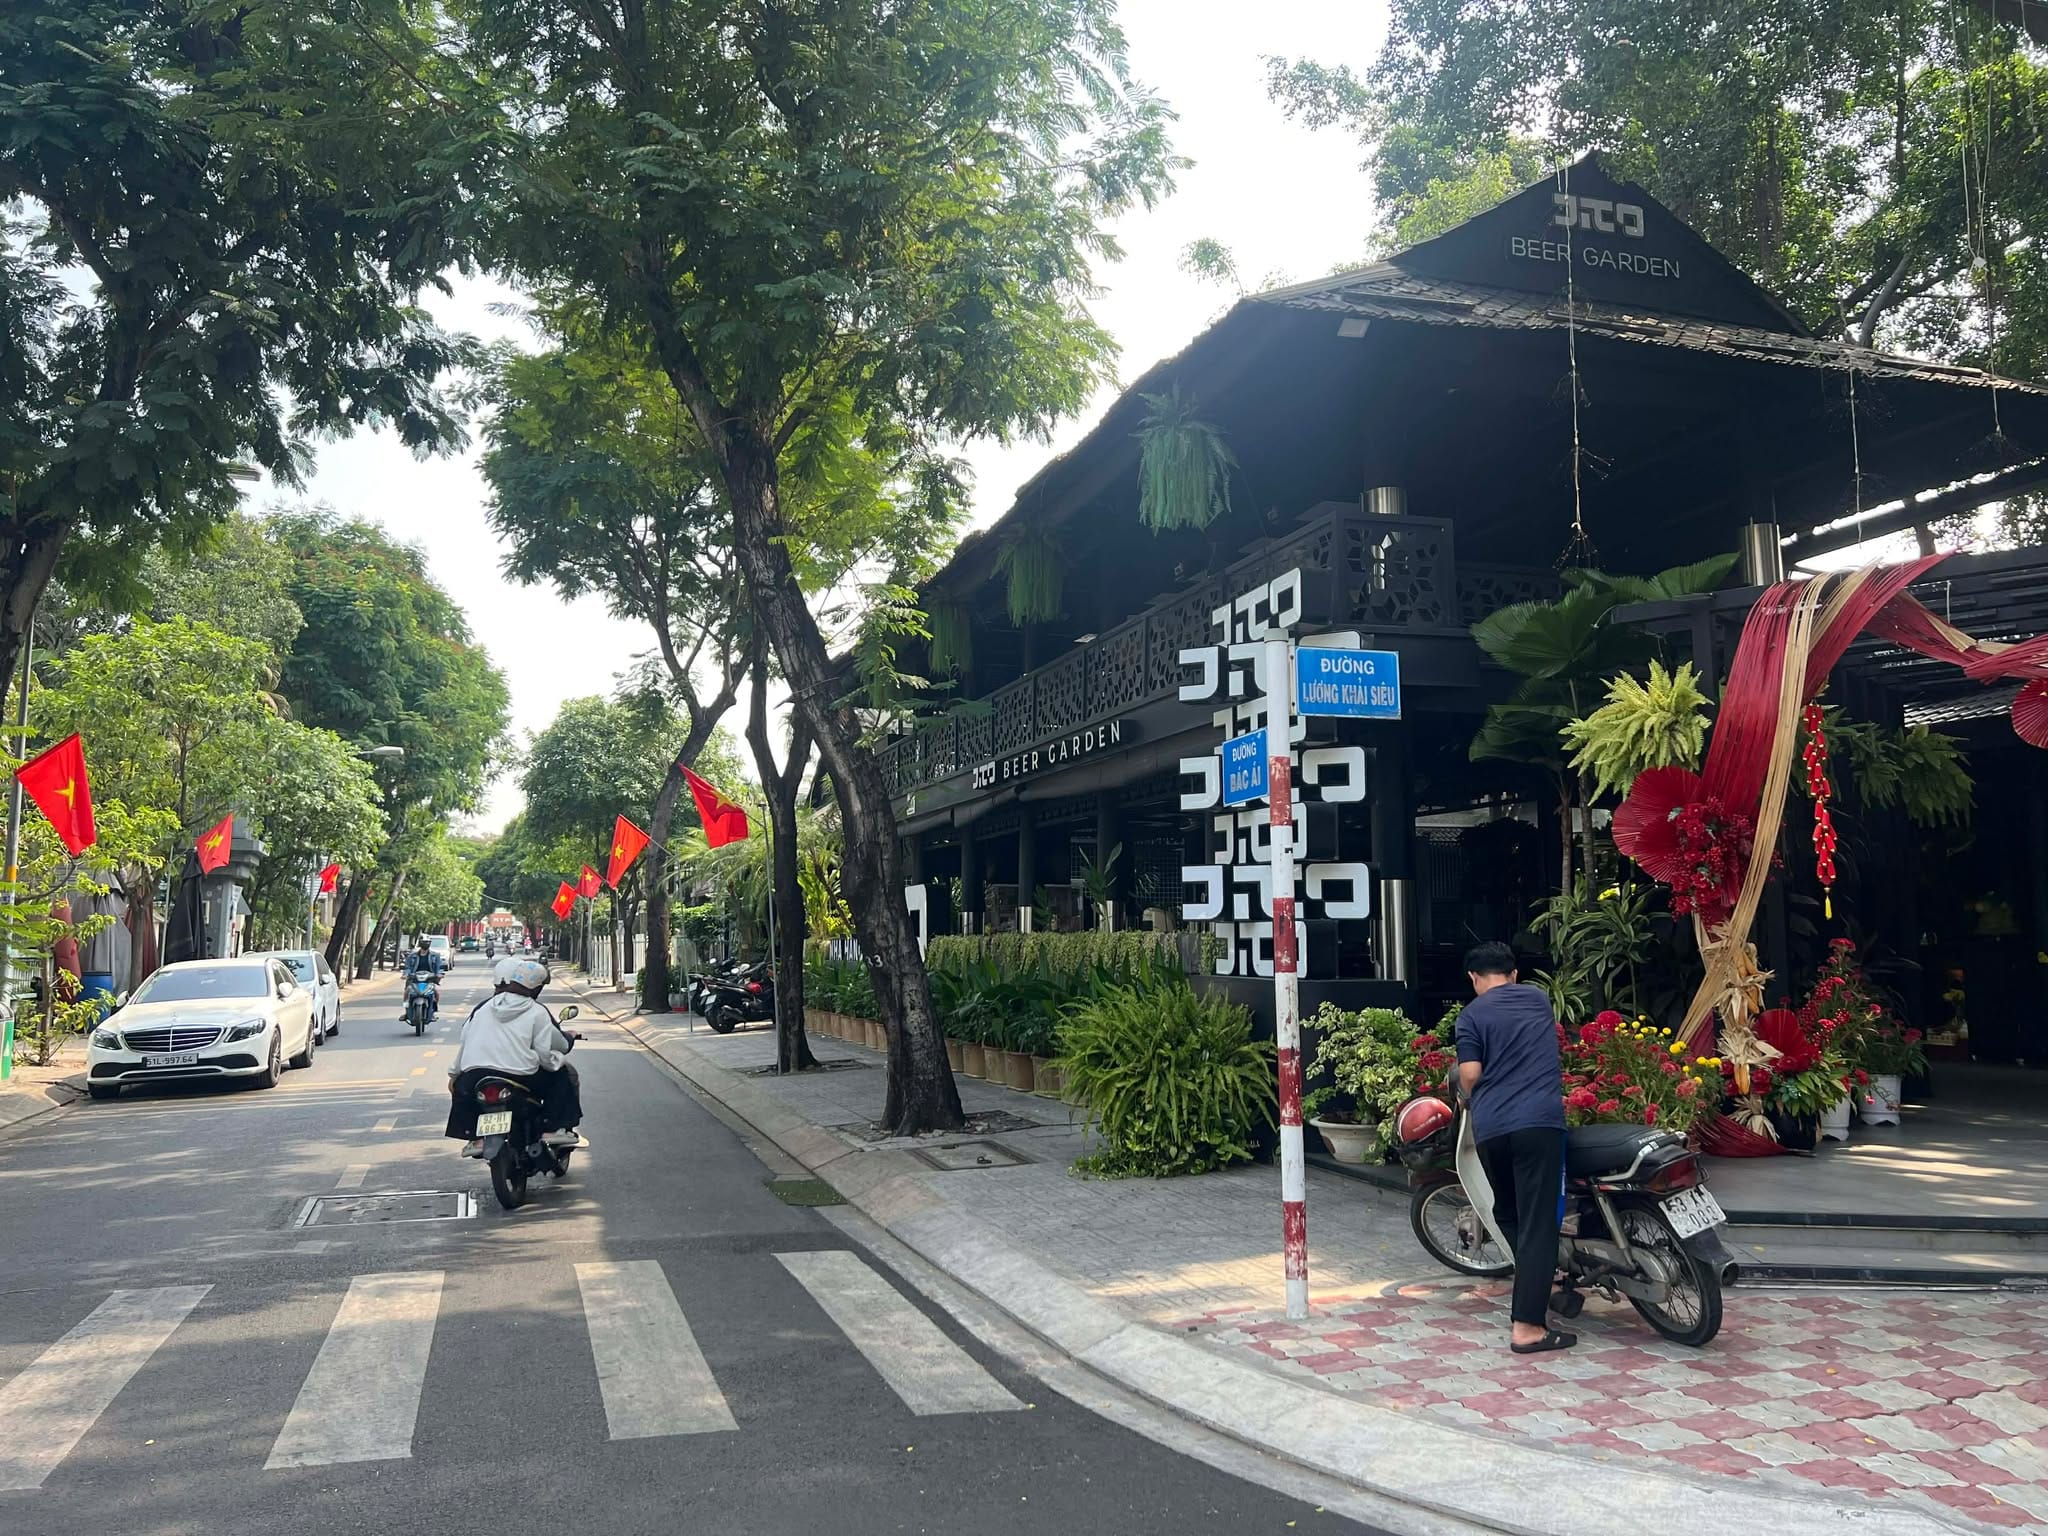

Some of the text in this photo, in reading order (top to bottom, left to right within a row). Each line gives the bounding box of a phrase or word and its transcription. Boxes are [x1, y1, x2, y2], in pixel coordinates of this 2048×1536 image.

[1511, 236, 1680, 279] BEER GARDEN
[1320, 655, 1375, 675] ĐƯỜNG
[1341, 676, 1368, 705] KHẢI
[1370, 681, 1395, 706] SIÊU
[1003, 751, 1039, 779] BEER
[1048, 720, 1120, 764] GARDEN
[1232, 741, 1257, 762] ĐƯỜNG
[1230, 760, 1261, 793] BÁC ÁI
